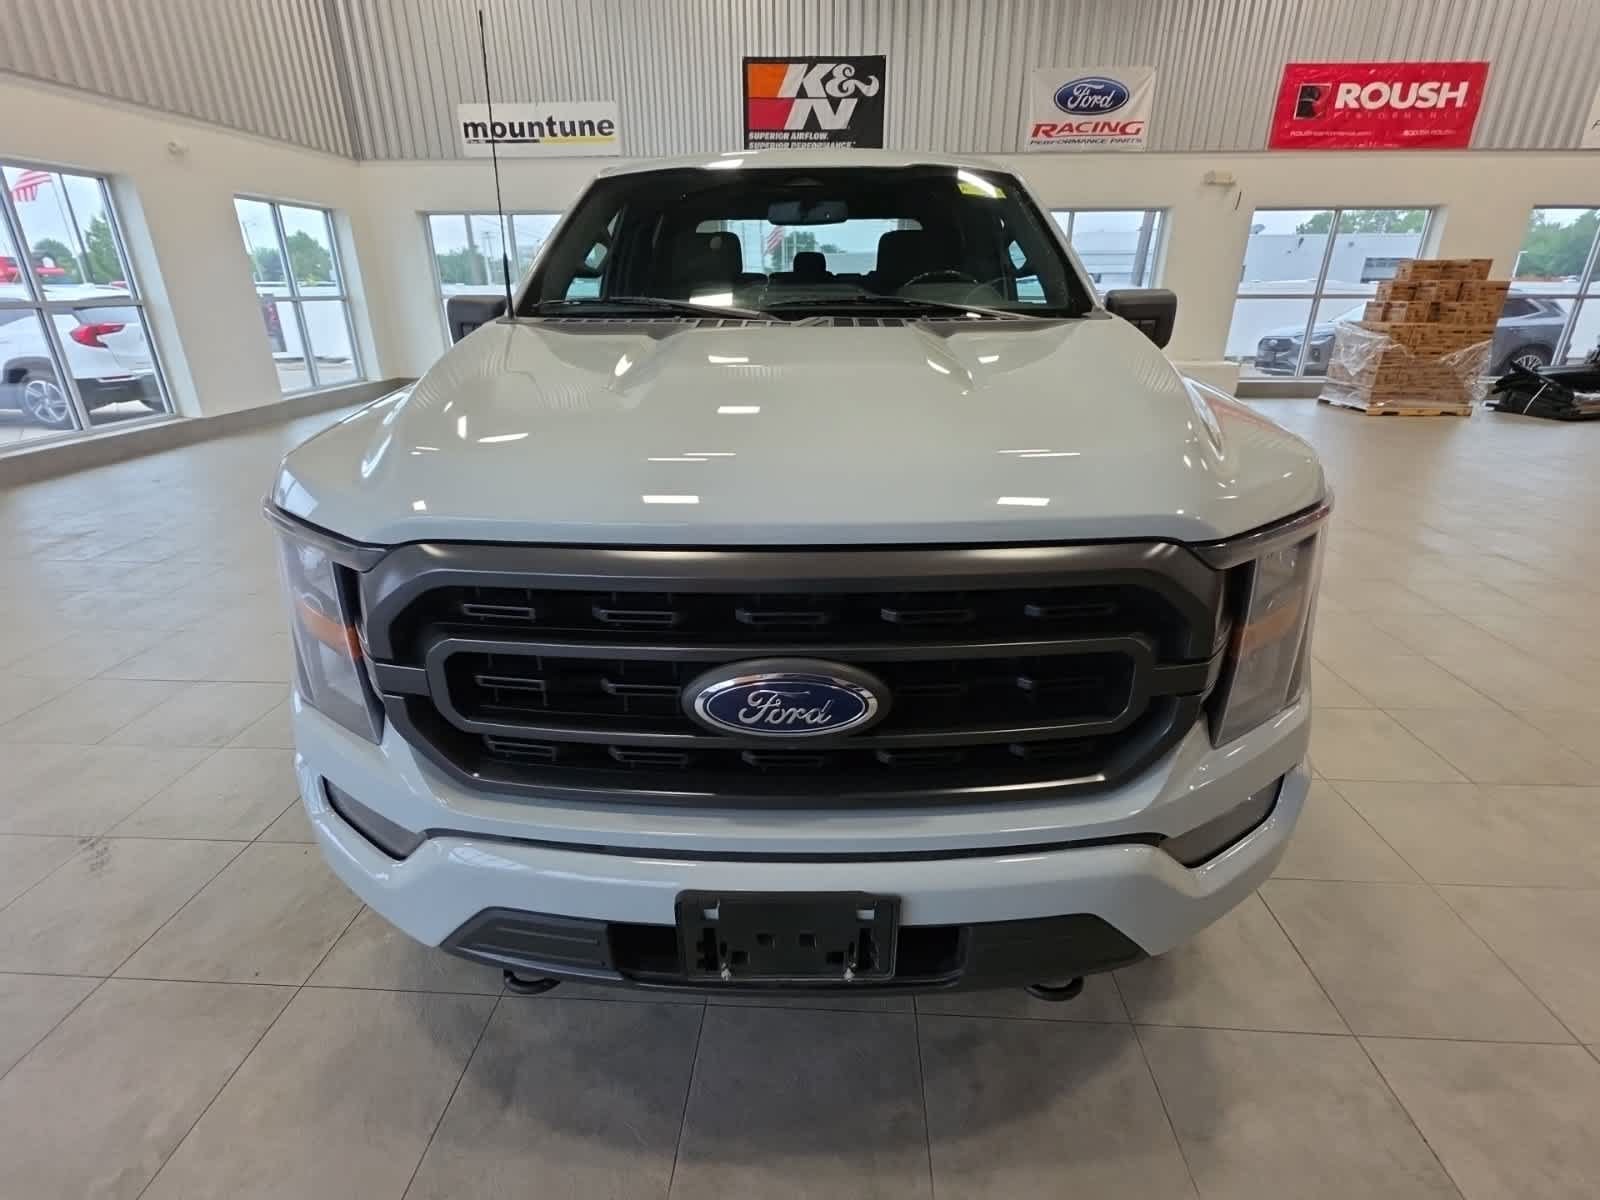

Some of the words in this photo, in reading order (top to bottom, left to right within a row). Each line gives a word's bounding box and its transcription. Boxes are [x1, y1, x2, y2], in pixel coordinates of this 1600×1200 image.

[1067, 83, 1117, 109] Ford
[1334, 81, 1469, 110] ROUSH
[463, 115, 615, 138] mountune
[748, 131, 790, 141] SUPERIOR
[1031, 120, 1145, 139] RACING
[738, 689, 834, 725] Ford
